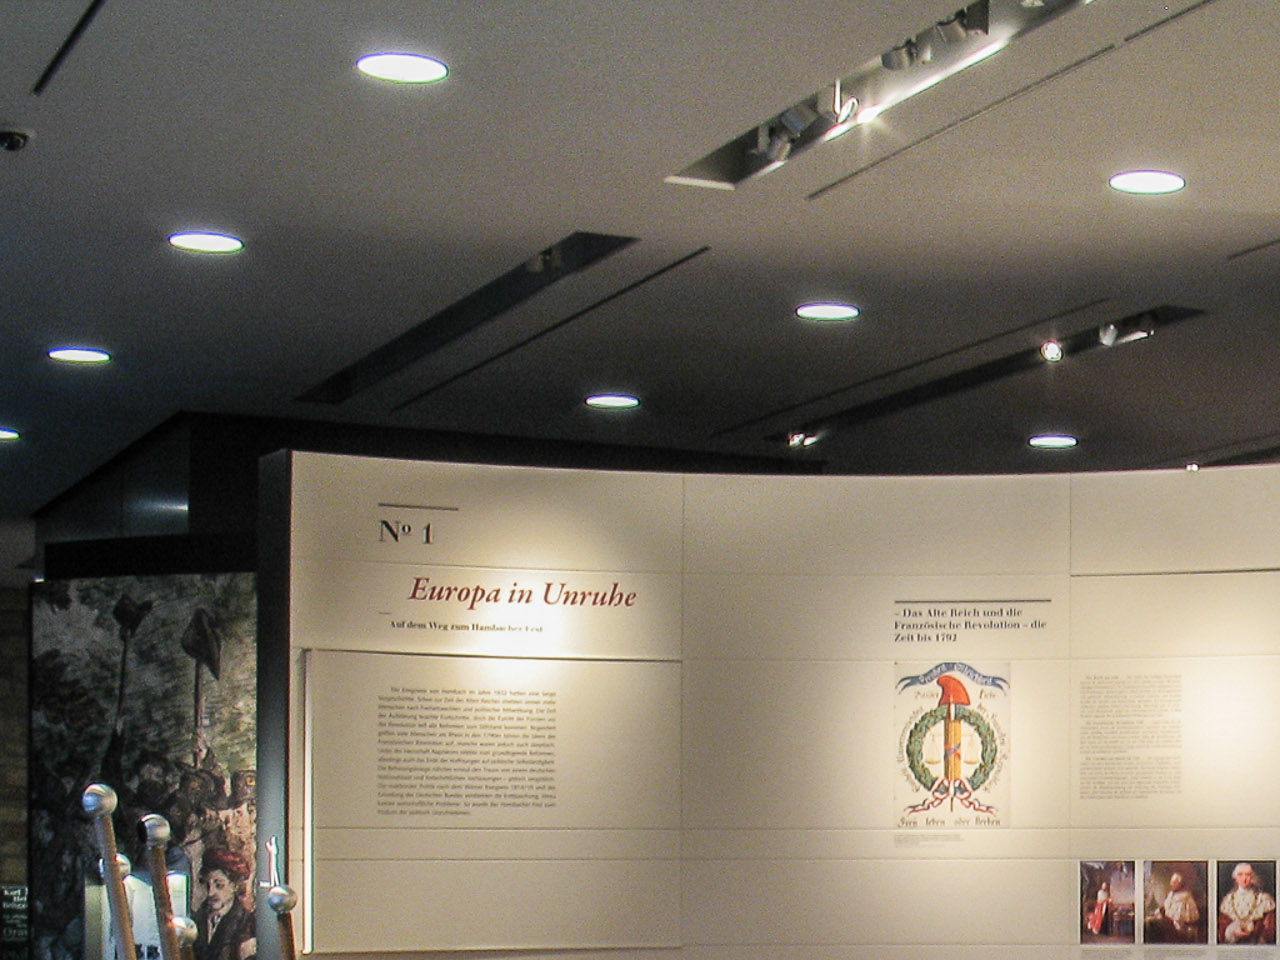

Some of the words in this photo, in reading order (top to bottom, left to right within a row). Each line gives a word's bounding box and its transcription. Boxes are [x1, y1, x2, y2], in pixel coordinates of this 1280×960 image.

[422, 522, 434, 545] 1
[408, 576, 501, 611] Europa
[509, 582, 533, 605] in
[544, 581, 638, 608] Unruhe
[903, 608, 923, 618] Das
[926, 608, 947, 618] Alte
[950, 608, 980, 618] Reich
[983, 607, 1004, 618] und
[1006, 607, 1023, 617] die
[406, 620, 427, 631] dem
[428, 621, 449, 633] Weg
[450, 623, 470, 632] zum
[894, 620, 962, 631] Französische
[964, 620, 1021, 630] Revolution
[1030, 619, 1047, 629] die
[894, 632, 915, 643] Zeit
[916, 632, 932, 642] bis
